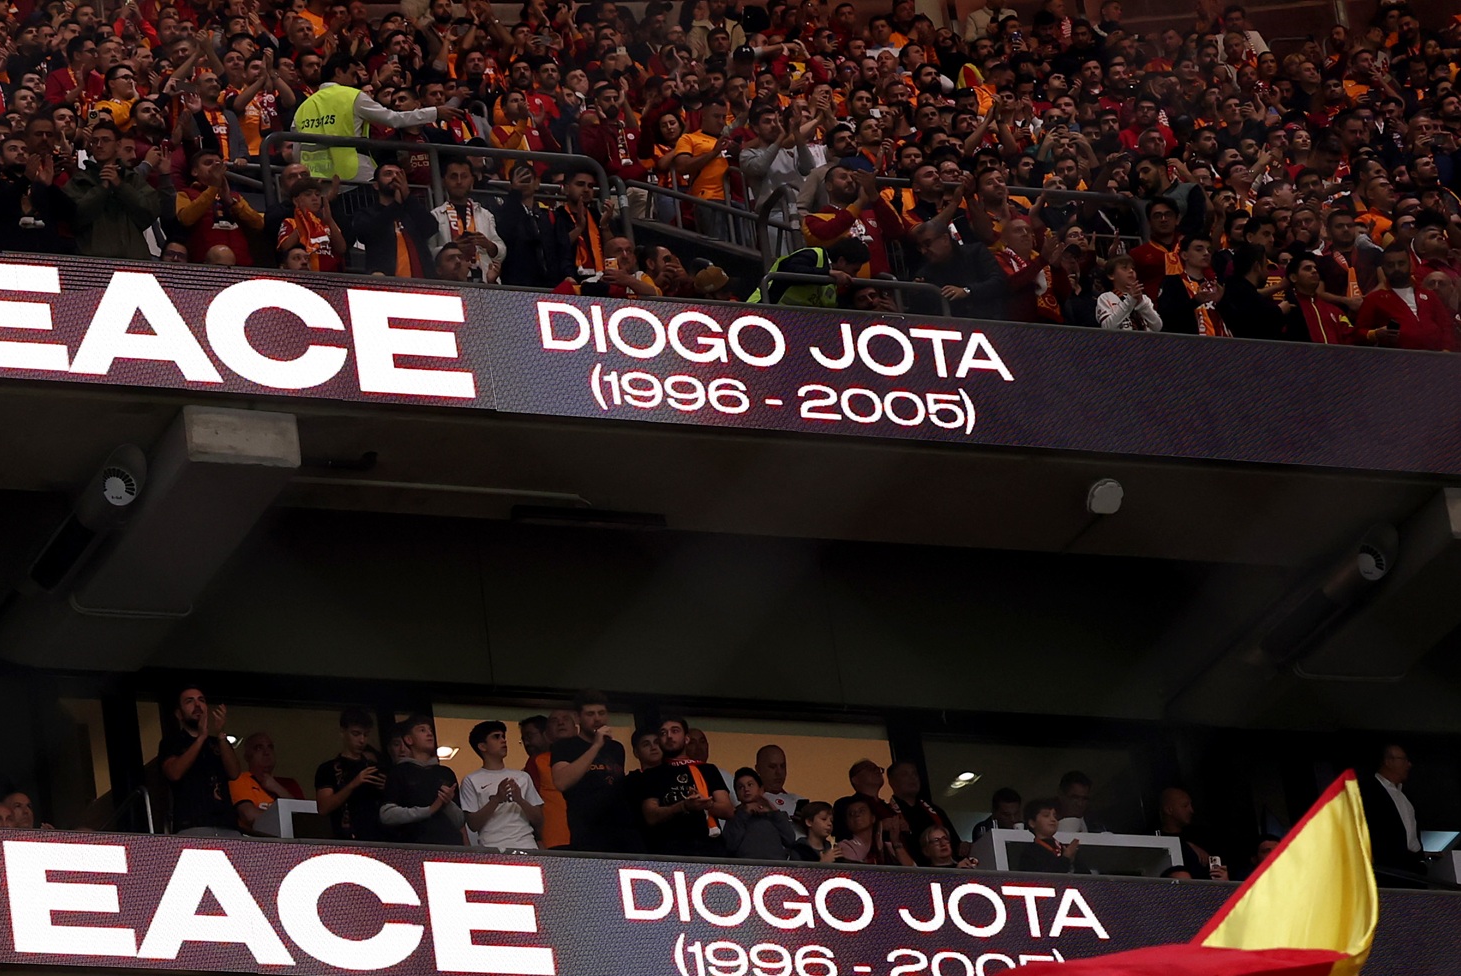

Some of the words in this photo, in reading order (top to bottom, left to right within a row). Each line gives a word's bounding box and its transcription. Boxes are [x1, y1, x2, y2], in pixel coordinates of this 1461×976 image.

[537, 301, 786, 367] DIOGO
[809, 323, 1014, 381] JOTA
[590, 362, 750, 414] (1996
[798, 384, 976, 435] 2005)
[619, 868, 875, 932] DIOGO
[898, 882, 1110, 939] JOTA
